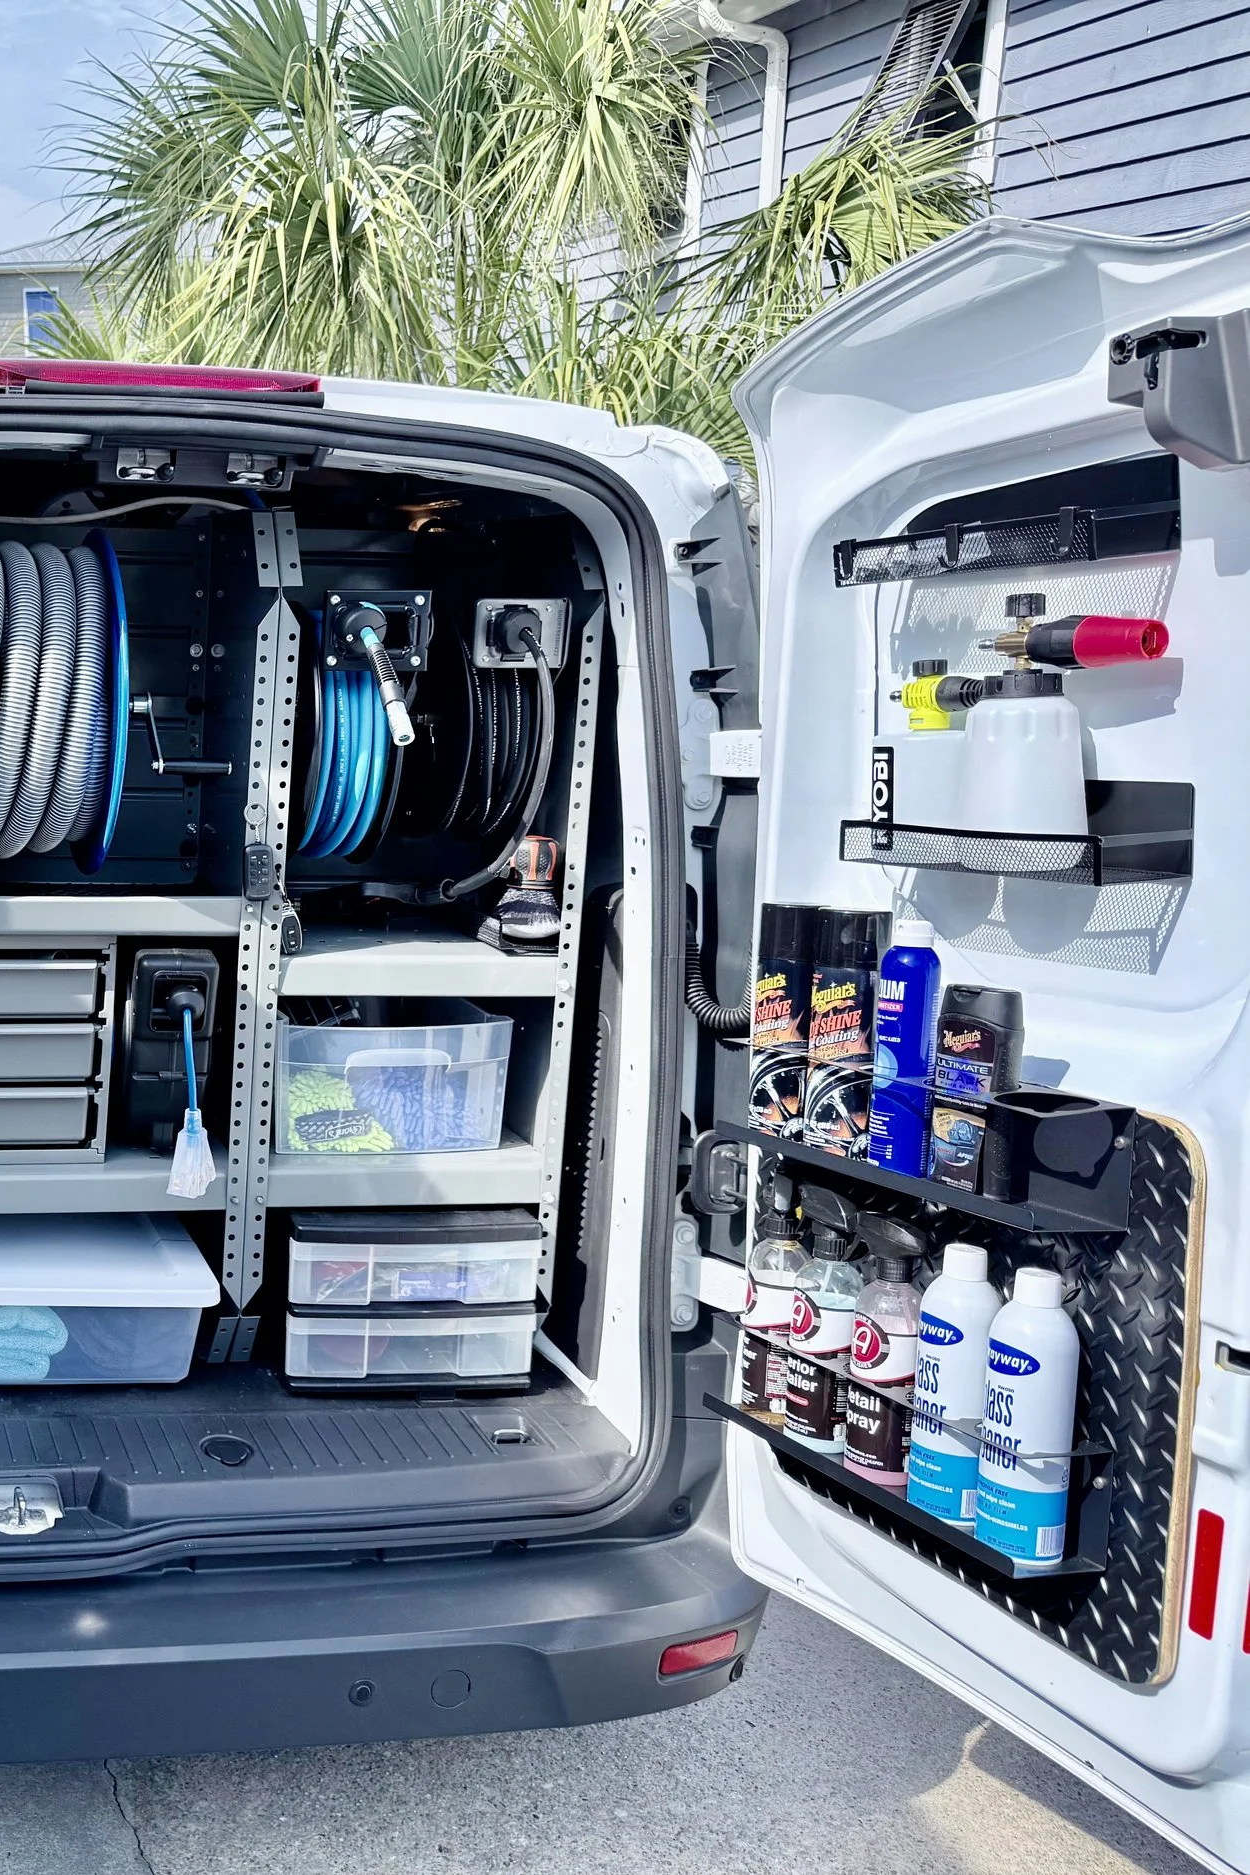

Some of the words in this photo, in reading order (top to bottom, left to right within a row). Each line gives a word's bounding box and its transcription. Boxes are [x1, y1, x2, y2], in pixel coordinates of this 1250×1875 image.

[819, 1010, 862, 1034] SHINE
[816, 1029, 860, 1046] Coating
[943, 1029, 981, 1049] Meguiar's
[938, 1059, 989, 1075] ULTIMATE
[998, 1499, 1016, 1509] clean
